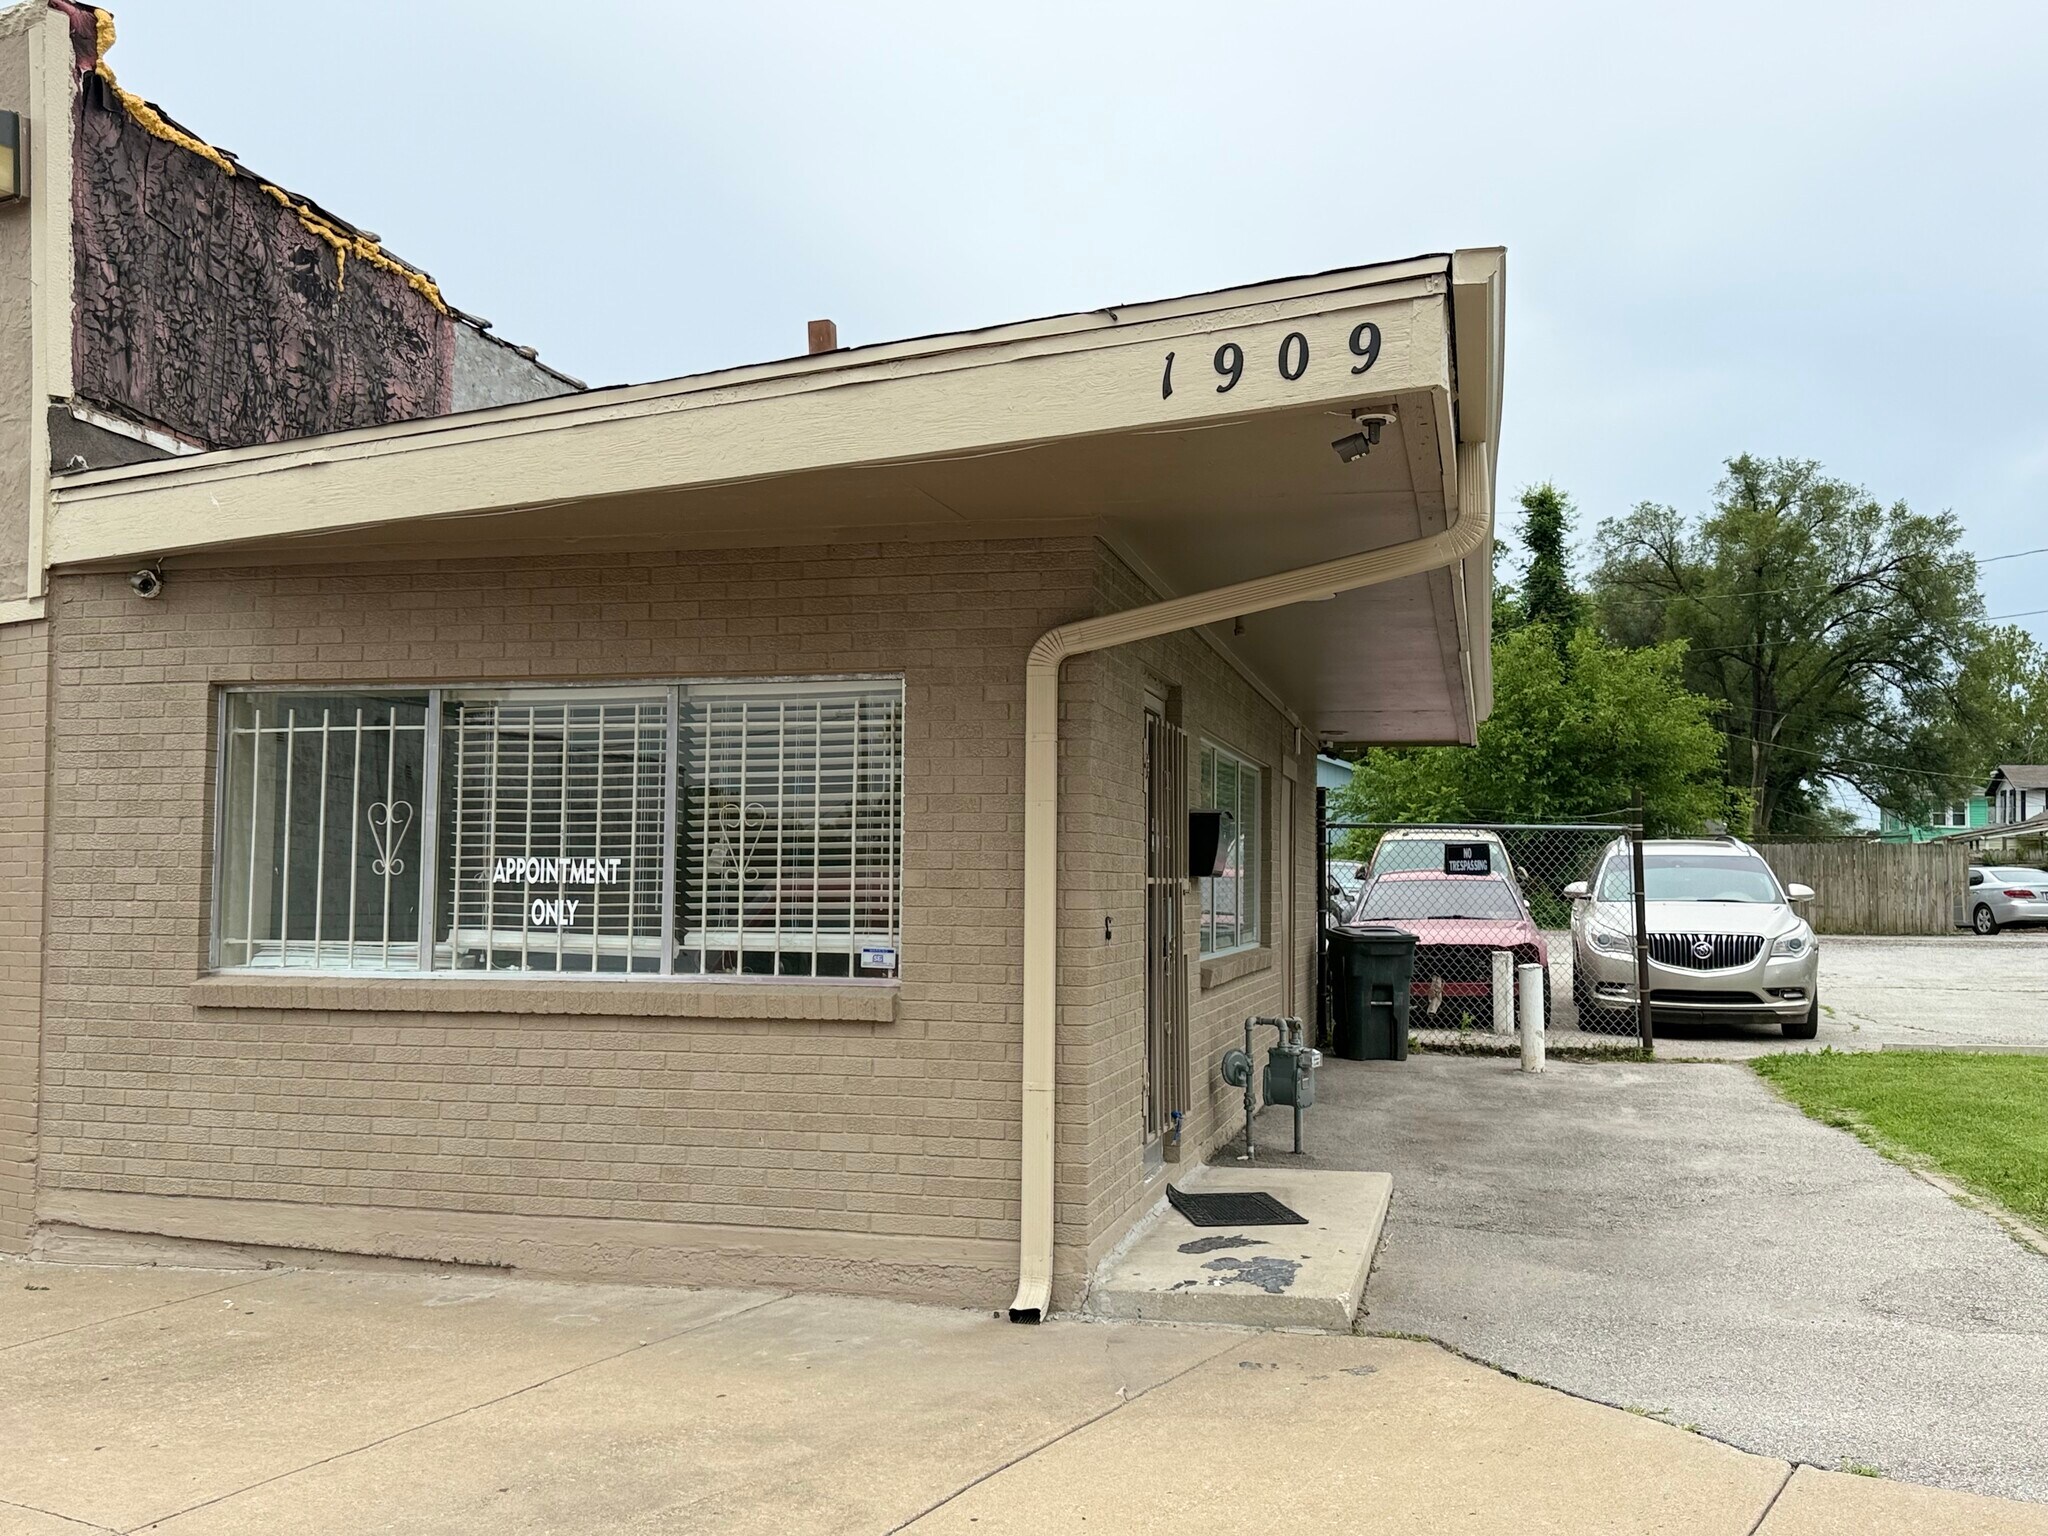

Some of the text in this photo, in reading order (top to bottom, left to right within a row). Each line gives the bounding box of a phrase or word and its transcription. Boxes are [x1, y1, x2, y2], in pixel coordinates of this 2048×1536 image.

[1463, 848, 1472, 859] NO
[493, 857, 621, 885] APPOINTMENT
[1449, 860, 1488, 871] TRESPASSING
[531, 899, 580, 926] ONLY
